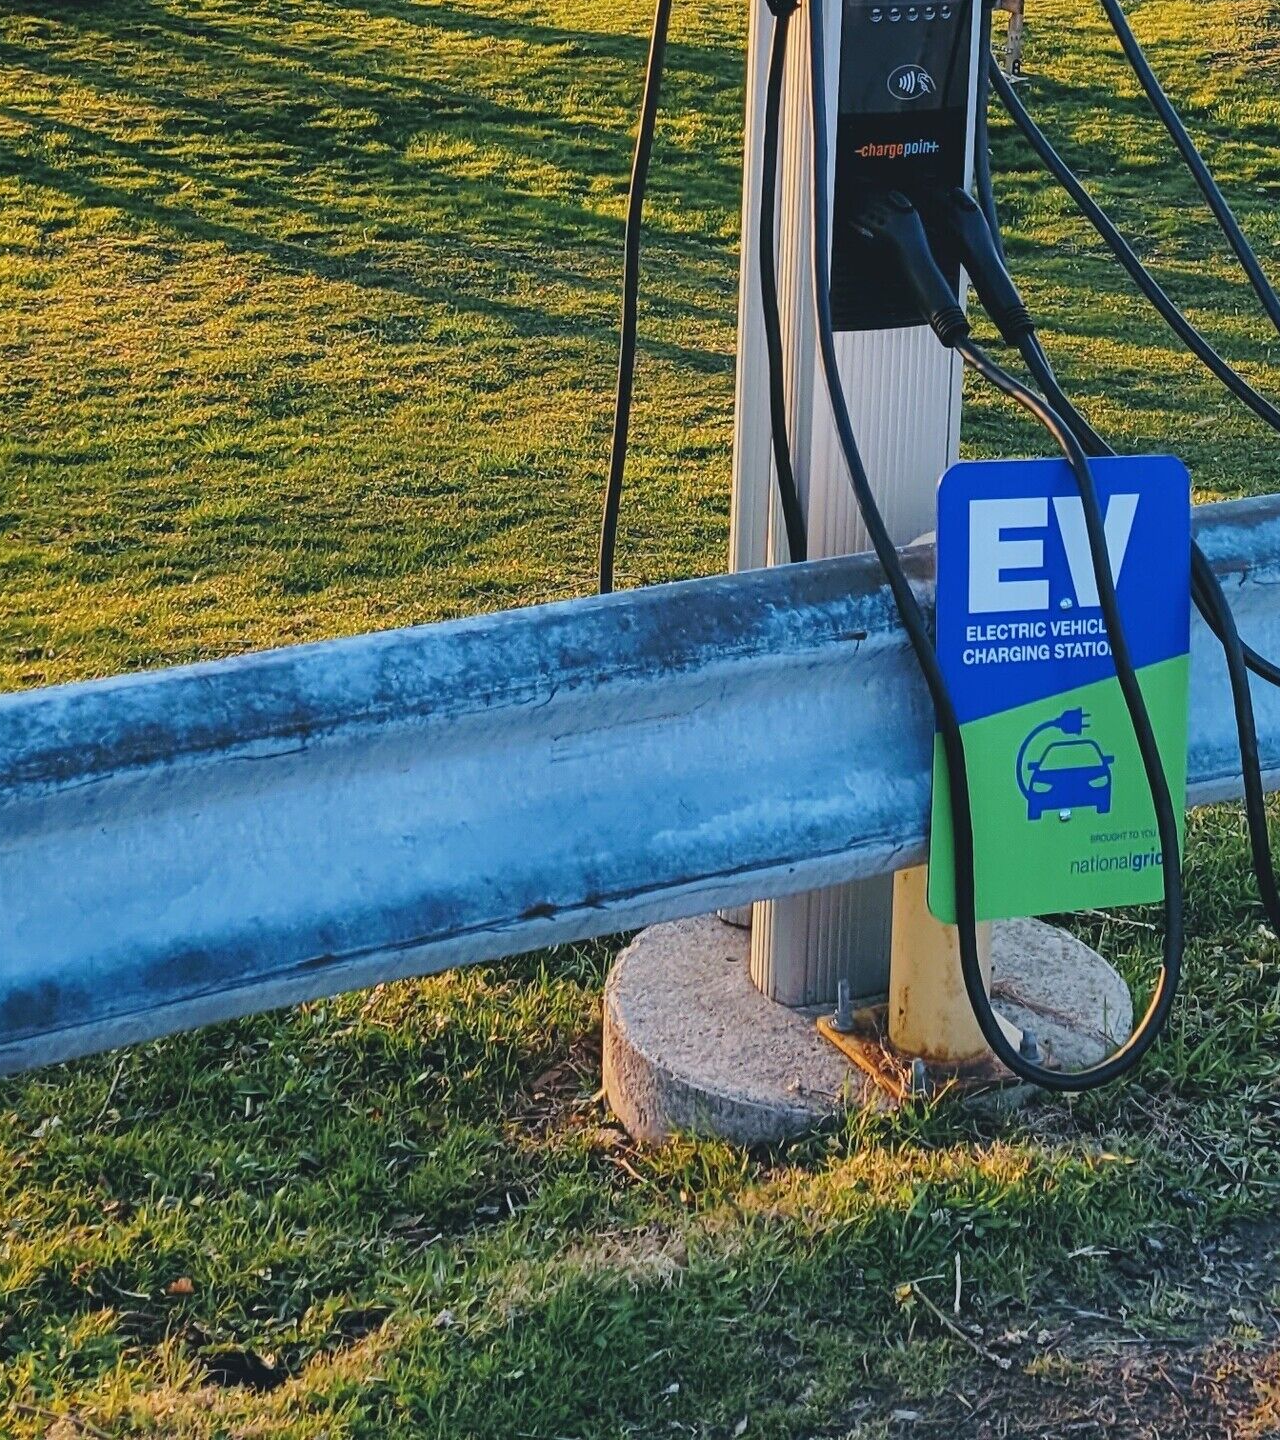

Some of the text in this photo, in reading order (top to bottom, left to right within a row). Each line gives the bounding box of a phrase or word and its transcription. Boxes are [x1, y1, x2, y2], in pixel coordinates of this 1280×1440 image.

[854, 139, 939, 158] chargepoint
[968, 493, 1140, 614] EV
[966, 618, 1107, 642] ELECTRIC VEHICL
[963, 645, 1050, 665] CHARGING
